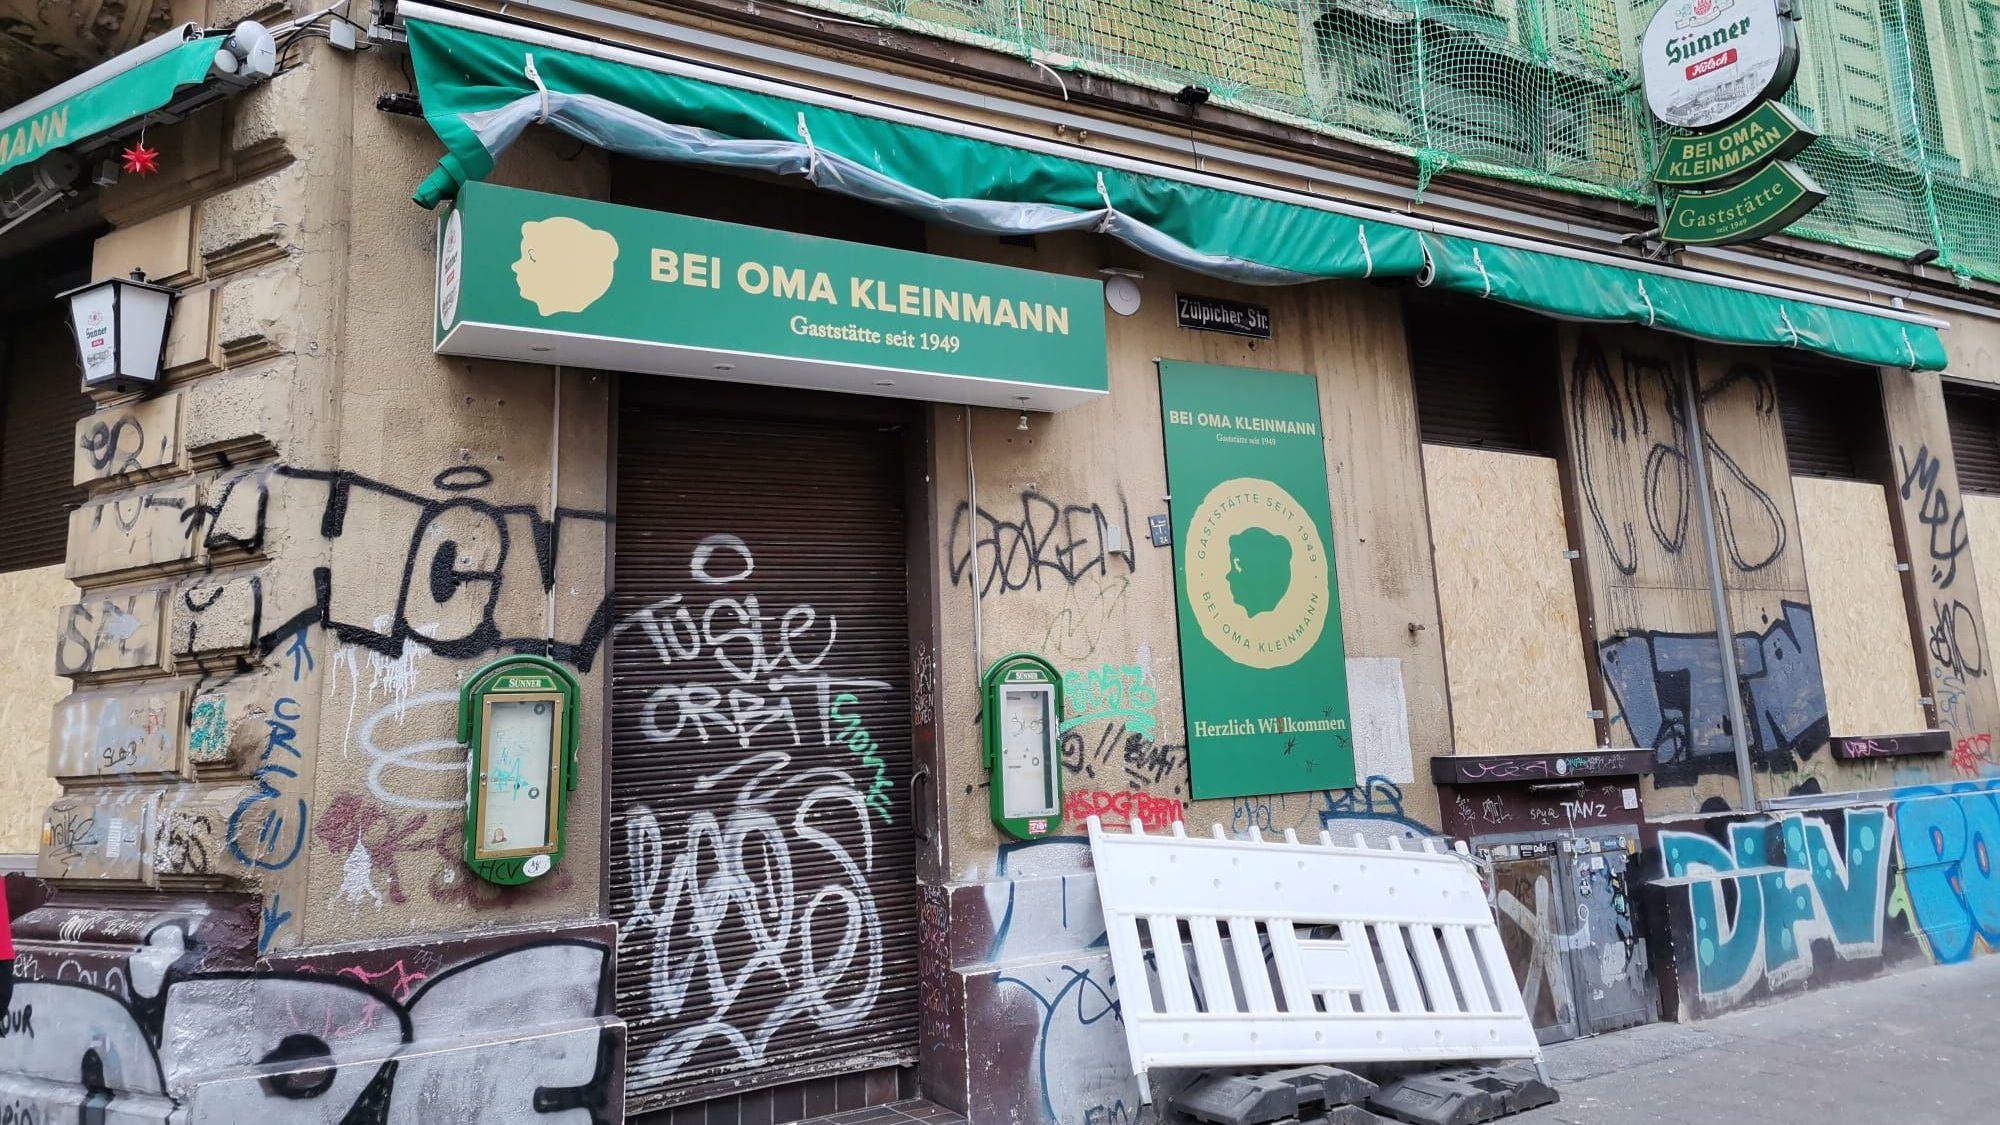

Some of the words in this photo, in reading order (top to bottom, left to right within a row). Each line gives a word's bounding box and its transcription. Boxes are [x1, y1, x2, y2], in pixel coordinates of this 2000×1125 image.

[1665, 16, 1751, 66] Sünner
[1691, 52, 1728, 77] Kölsch
[1669, 126, 1782, 177] KLEINMANN
[1682, 141, 1713, 160] BEI
[1719, 121, 1764, 151] OMA
[1678, 182, 1784, 228] Gaststätte
[1730, 218, 1748, 229] 1949
[650, 247, 721, 289] BEI
[736, 261, 837, 305] OMA
[850, 275, 1070, 336] KLEINMANN
[1180, 299, 1243, 325] Zülpicher
[1247, 308, 1269, 329] Str.
[790, 315, 881, 345] Gaststätte
[885, 330, 915, 349] seit
[919, 332, 960, 353] 1949
[1169, 410, 1193, 425] BEI
[1197, 413, 1232, 429] OMA
[1235, 416, 1316, 436] KLEINMANN
[1261, 437, 1276, 446] 1949
[1198, 493, 1260, 560] GASTSTÄTTE
[1265, 497, 1295, 522] SEIT
[1297, 525, 1318, 563] 1949
[1202, 591, 1220, 620] BEI
[1222, 623, 1251, 650] OMA
[1258, 592, 1320, 653] KLEINMANN
[1195, 718, 1255, 737] Herzlich
[1258, 716, 1346, 735] Wilkommen
